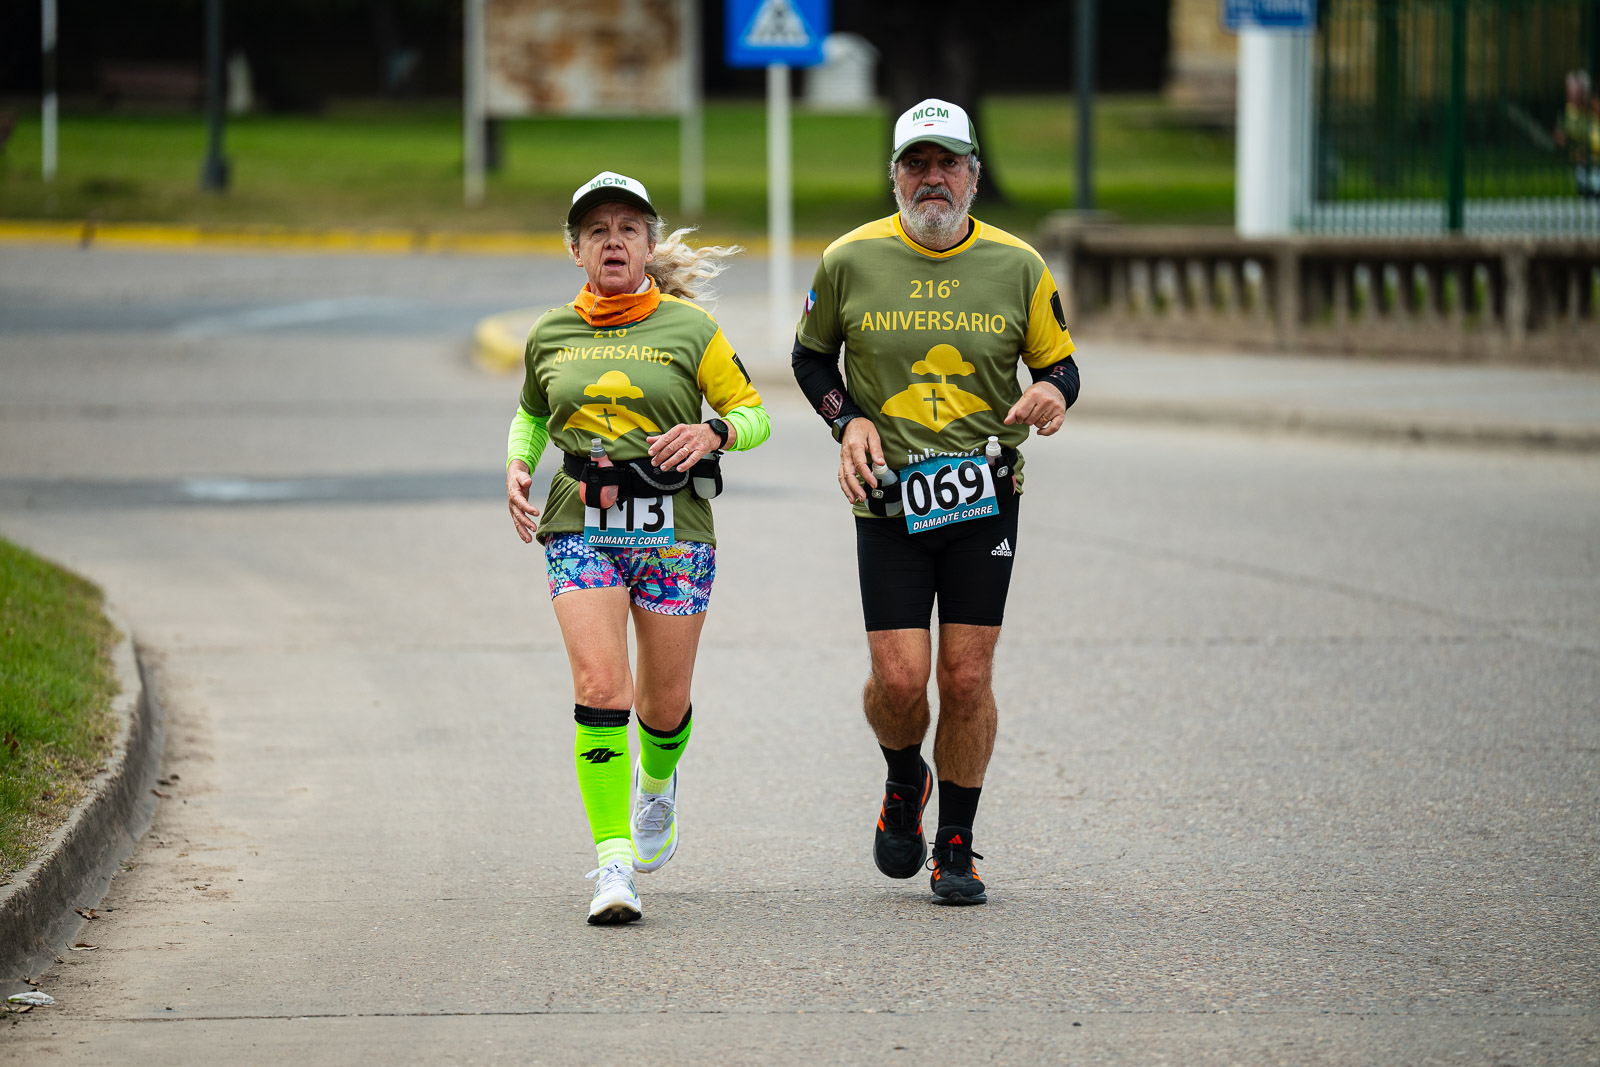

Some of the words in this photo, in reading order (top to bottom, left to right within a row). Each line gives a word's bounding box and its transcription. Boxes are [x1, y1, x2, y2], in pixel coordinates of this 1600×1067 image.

[912, 107, 949, 121] MCM
[590, 177, 627, 190] MCM
[909, 279, 960, 299] 216°
[860, 310, 1006, 334] ANIVERSARIO
[552, 344, 674, 366] ANIVERSARIO
[906, 460, 985, 517] 069
[912, 510, 960, 531] DIAMANTE
[961, 504, 993, 519] CORRE
[588, 535, 636, 545] DIAMANTE
[637, 535, 670, 545] CORRE
[991, 549, 1012, 557] adidas
